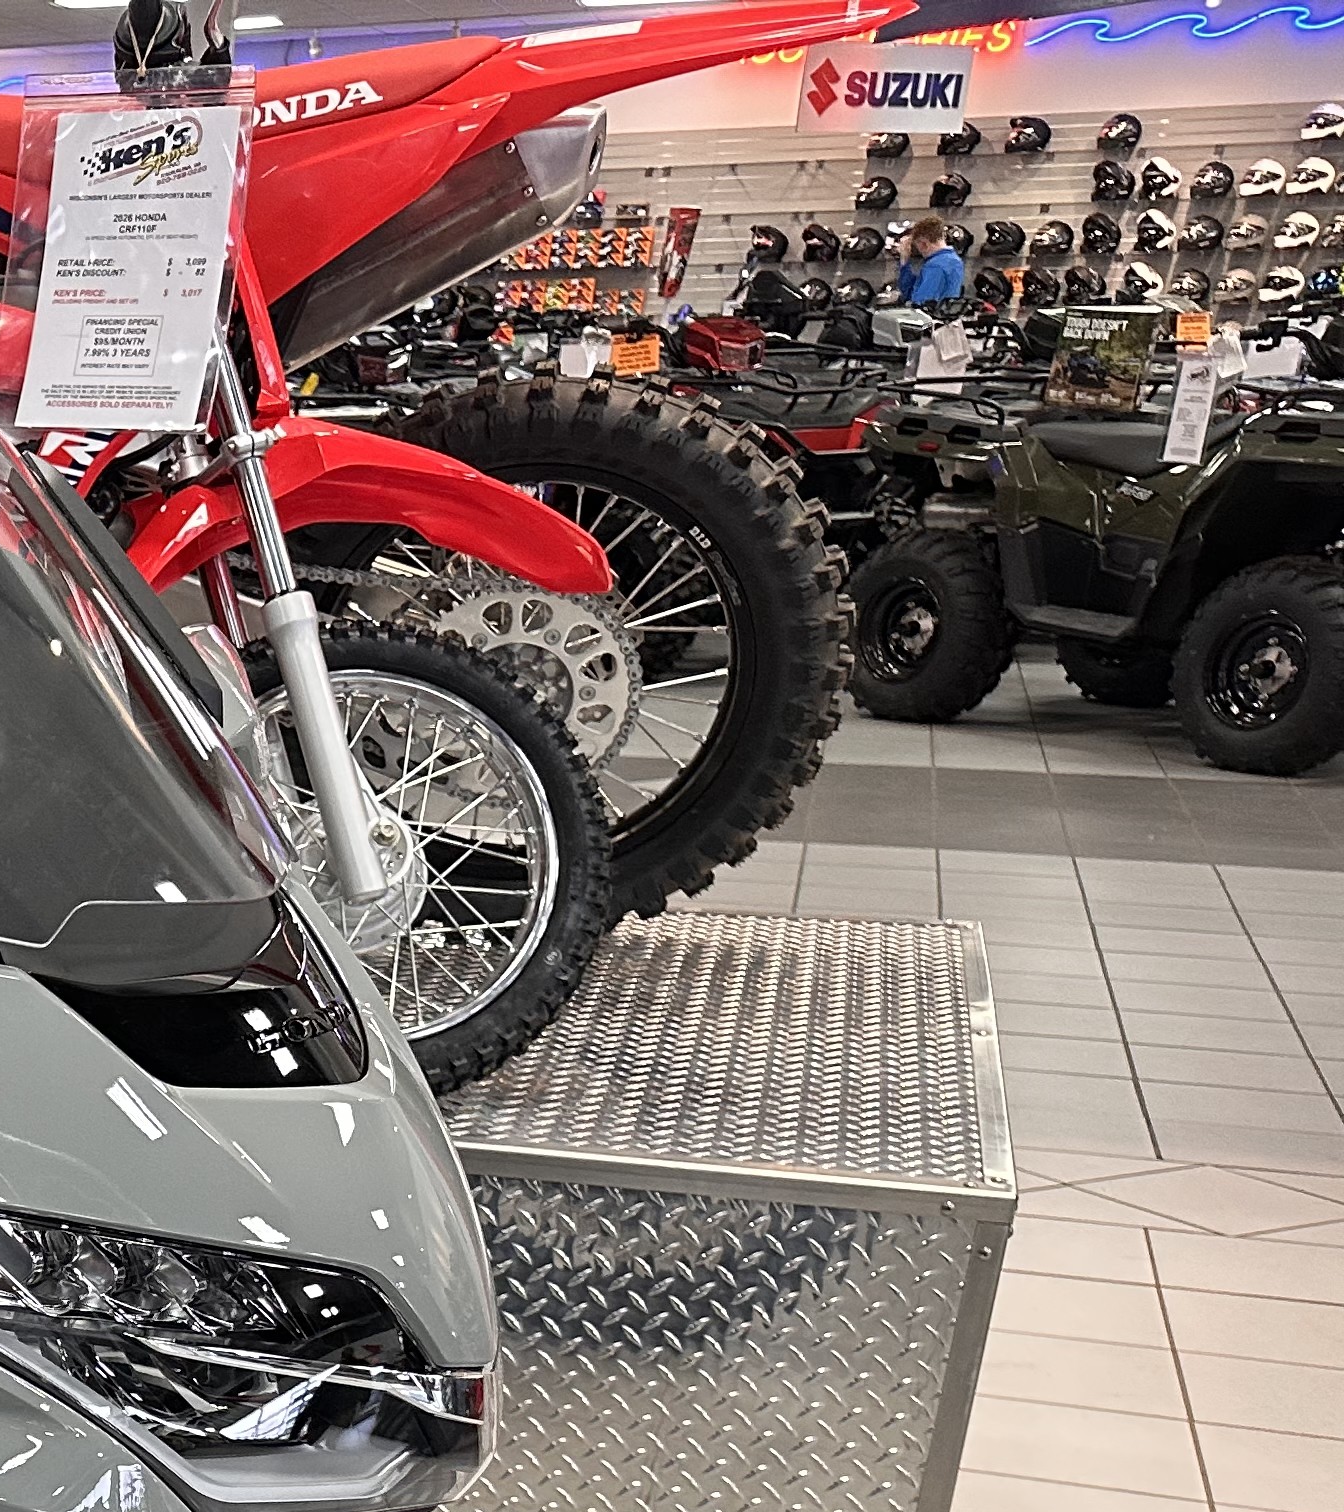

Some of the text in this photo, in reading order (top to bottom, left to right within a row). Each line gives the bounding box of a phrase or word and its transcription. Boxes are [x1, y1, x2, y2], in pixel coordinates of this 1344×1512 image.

[845, 70, 964, 109] SUZUKI
[253, 80, 384, 128] NDA
[135, 213, 167, 222] HONDA
[118, 225, 158, 234] CRF110F
[57, 258, 86, 267] RETAIL
[55, 268, 81, 277] KEN'S
[81, 268, 127, 277] DISCOUNT:
[53, 289, 78, 297] KEN'S
[79, 289, 107, 297] PRICE:
[85, 318, 159, 326] FINANCING SPECIAL
[94, 327, 121, 335] CREDIT
[120, 348, 151, 357] YEARS
[46, 400, 97, 408] ACCESSORIES
[99, 400, 119, 408] SOLD
